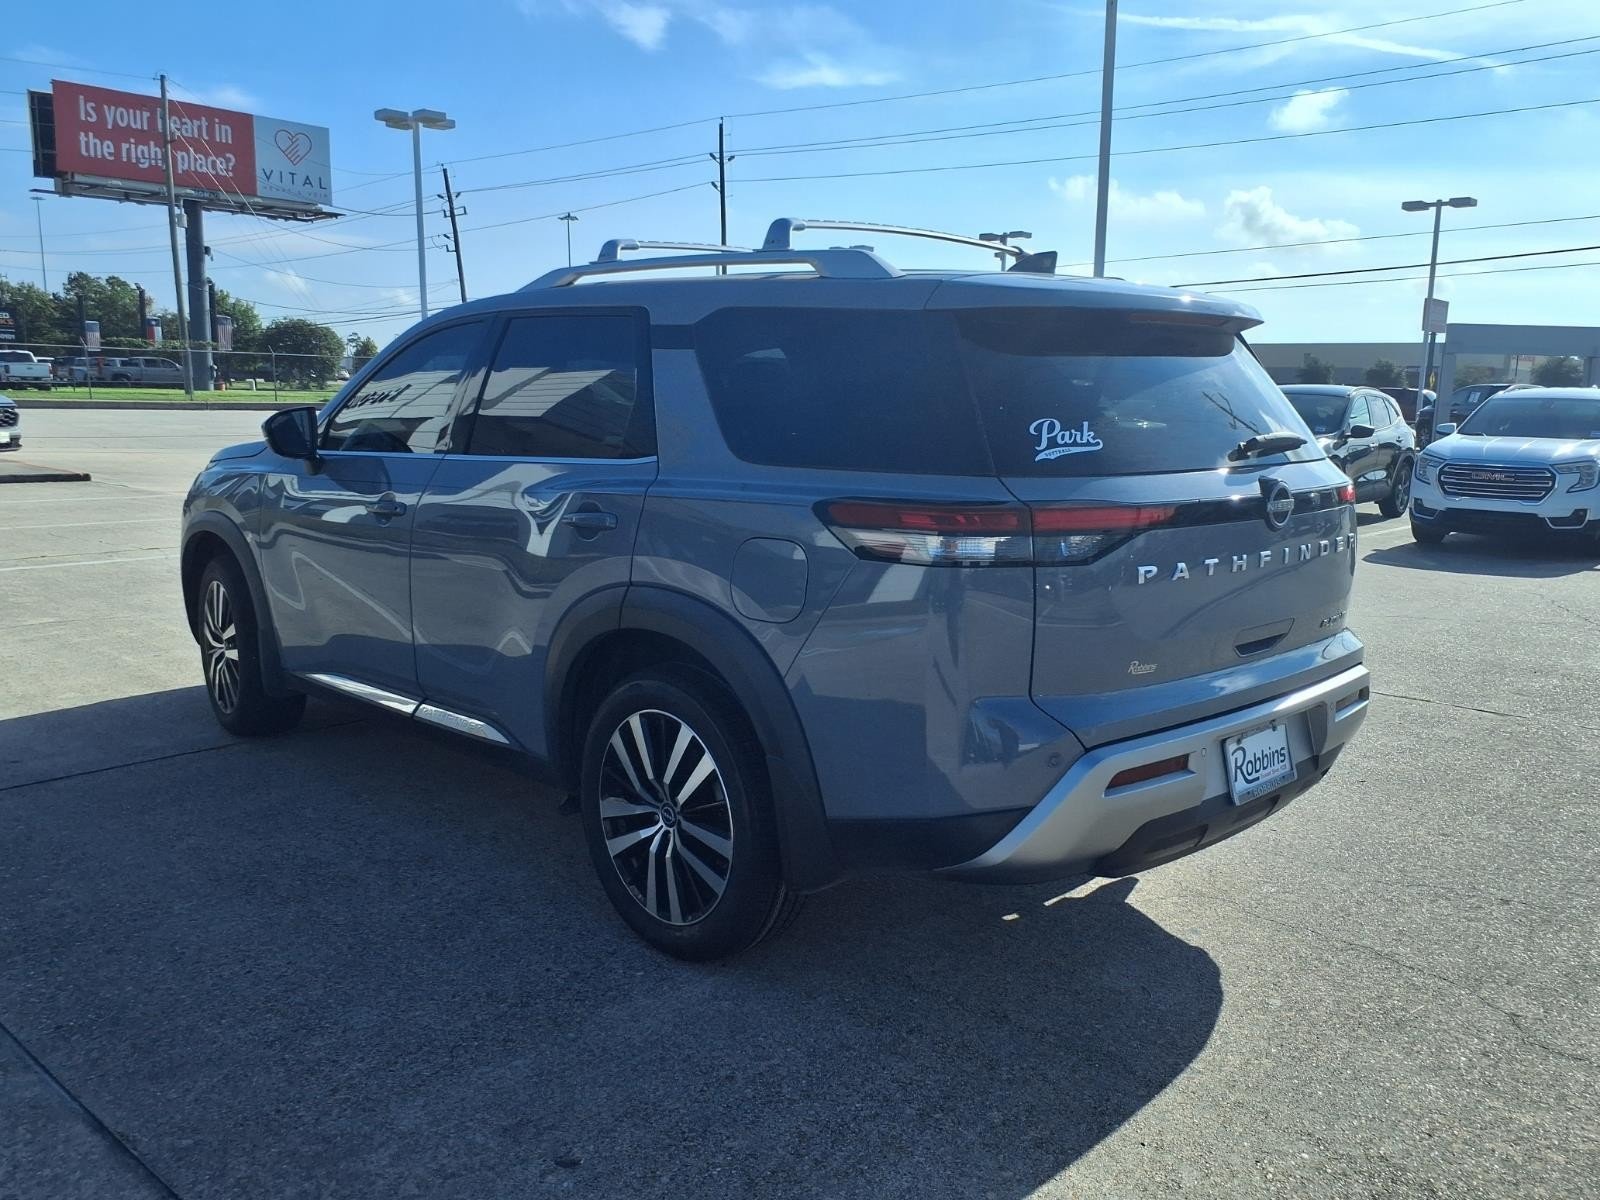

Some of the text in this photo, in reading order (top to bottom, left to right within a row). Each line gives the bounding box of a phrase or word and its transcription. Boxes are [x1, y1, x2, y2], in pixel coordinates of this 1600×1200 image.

[79, 95, 97, 122] Is
[103, 105, 150, 130] your
[214, 118, 233, 144] in
[80, 132, 115, 160] the
[176, 149, 236, 177] place?
[262, 167, 328, 190] VITAL
[1029, 418, 1103, 451] Park
[1471, 471, 1515, 481] GMC
[1231, 745, 1286, 785] Robbins
